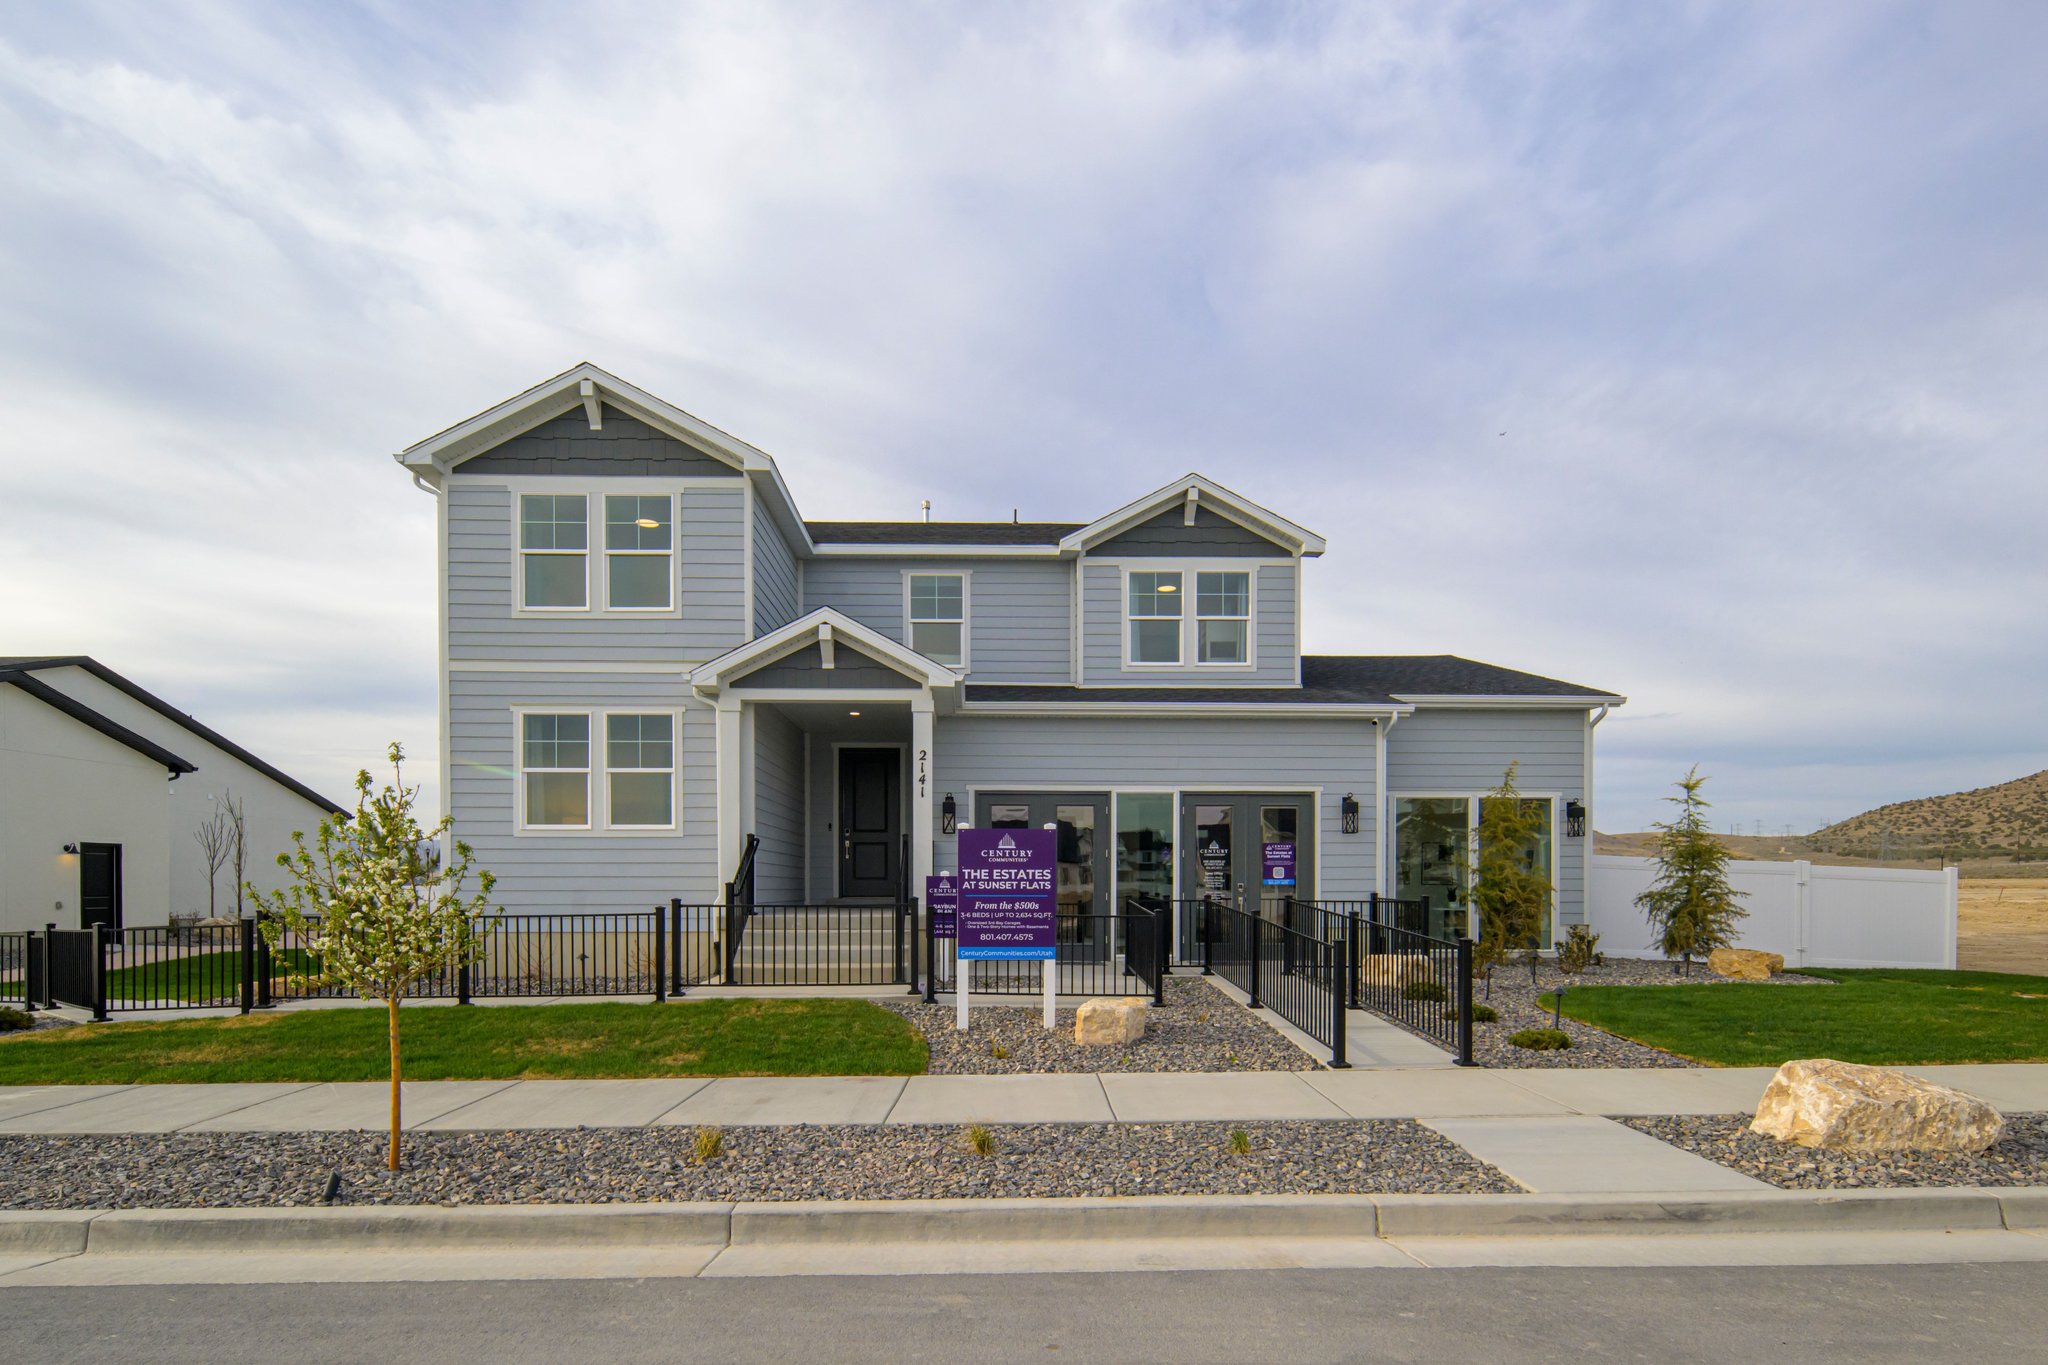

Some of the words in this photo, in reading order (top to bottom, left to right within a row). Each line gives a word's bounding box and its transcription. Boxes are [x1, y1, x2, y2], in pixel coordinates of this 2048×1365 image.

[918, 749, 927, 798] 2141
[962, 869, 989, 880] THE
[993, 869, 1051, 880] ESTATES
[962, 881, 976, 890] AT
[978, 881, 1018, 890] SUNSET
[1020, 881, 1051, 890] FLATS
[974, 901, 998, 910] From
[999, 901, 1013, 910] the
[1013, 901, 1040, 911] $500s
[980, 933, 1034, 941] 801.407.4575
[960, 950, 1053, 958] CenturyCommunities.com/Utah
